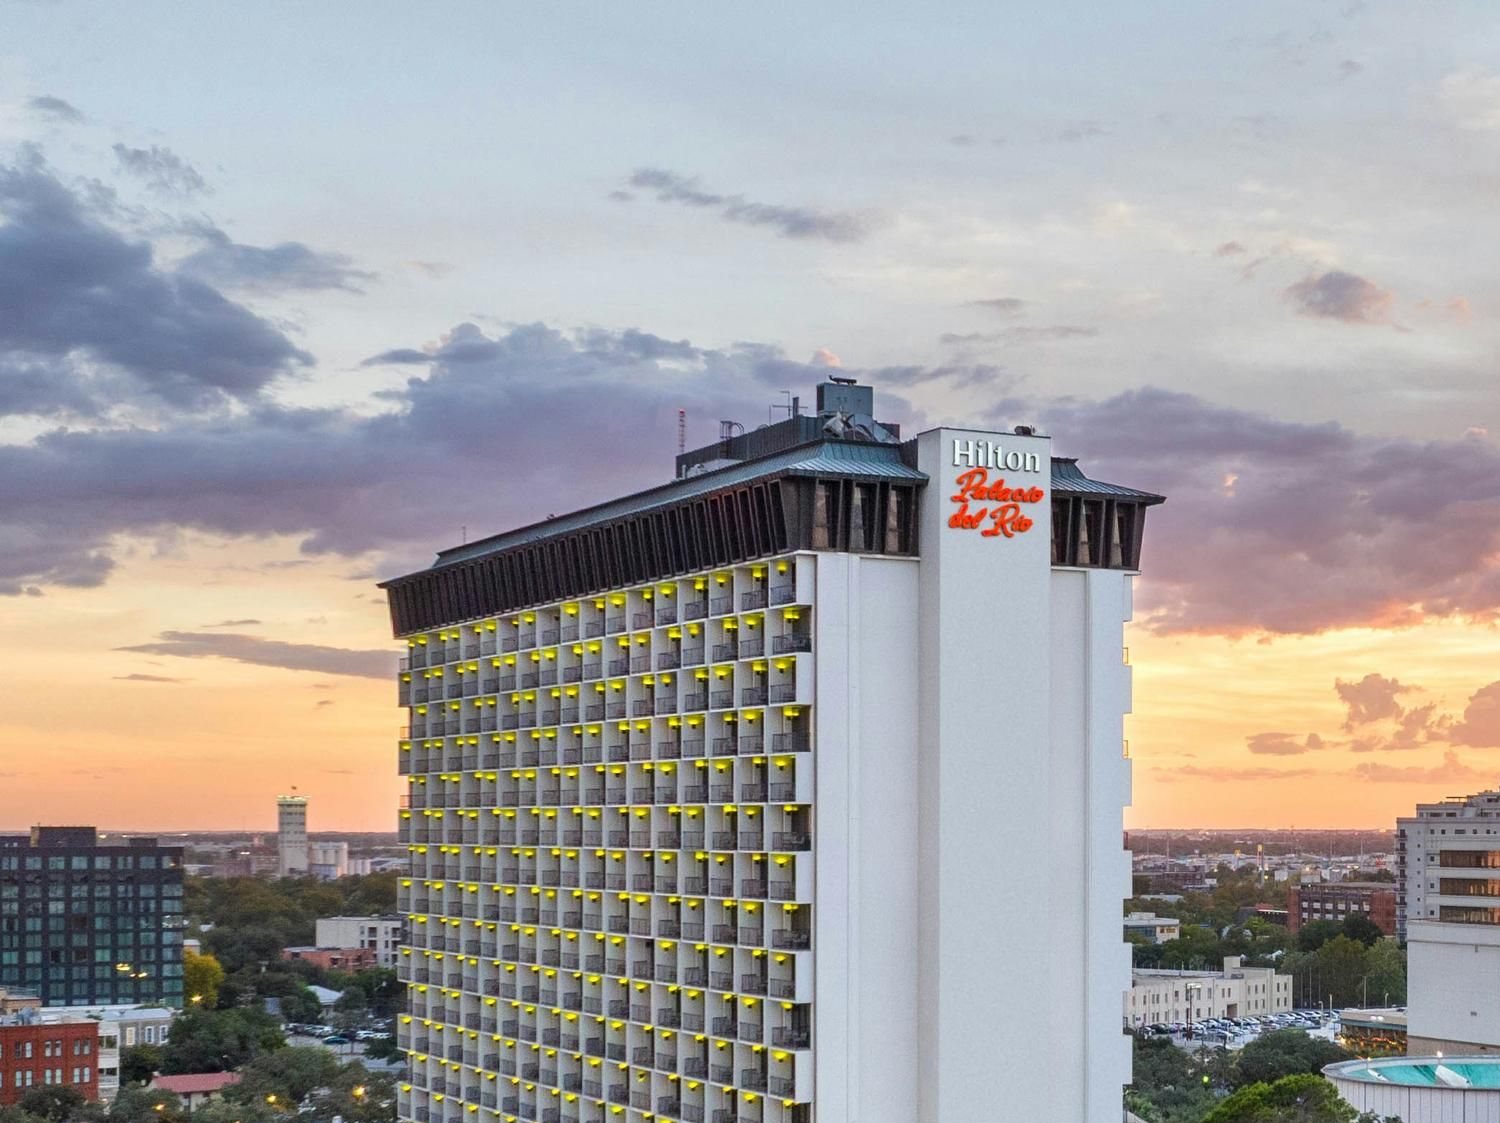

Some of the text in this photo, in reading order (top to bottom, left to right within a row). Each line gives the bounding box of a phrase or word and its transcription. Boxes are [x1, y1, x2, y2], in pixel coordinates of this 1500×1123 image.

[953, 440, 1041, 473] Hilton
[950, 468, 1044, 503] Palacio
[948, 502, 1033, 538] del Rio
